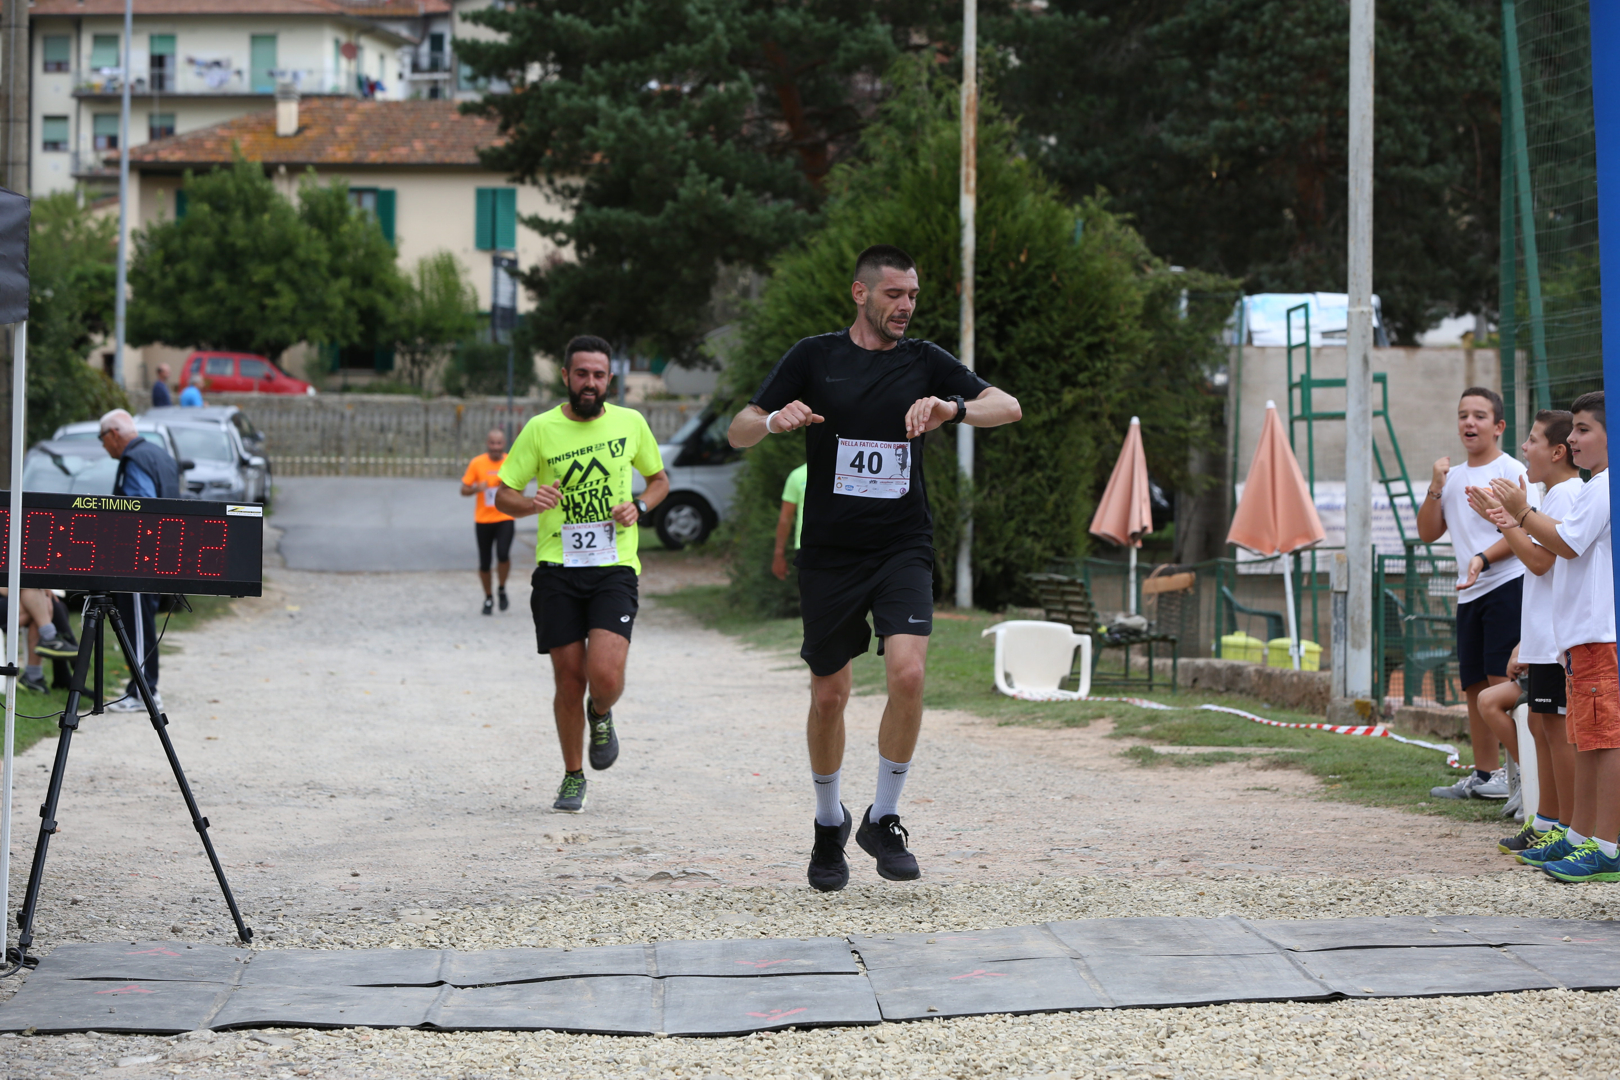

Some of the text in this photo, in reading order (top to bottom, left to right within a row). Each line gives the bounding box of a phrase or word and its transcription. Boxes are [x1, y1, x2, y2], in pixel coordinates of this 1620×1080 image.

[547, 445, 594, 467] FINISHER
[849, 450, 883, 475] 40
[565, 475, 610, 493] SCOTT
[71, 496, 142, 511] ALGE-TIMING
[560, 484, 614, 507] ULTRA
[561, 497, 613, 522] TRAIL
[571, 531, 597, 550] 32
